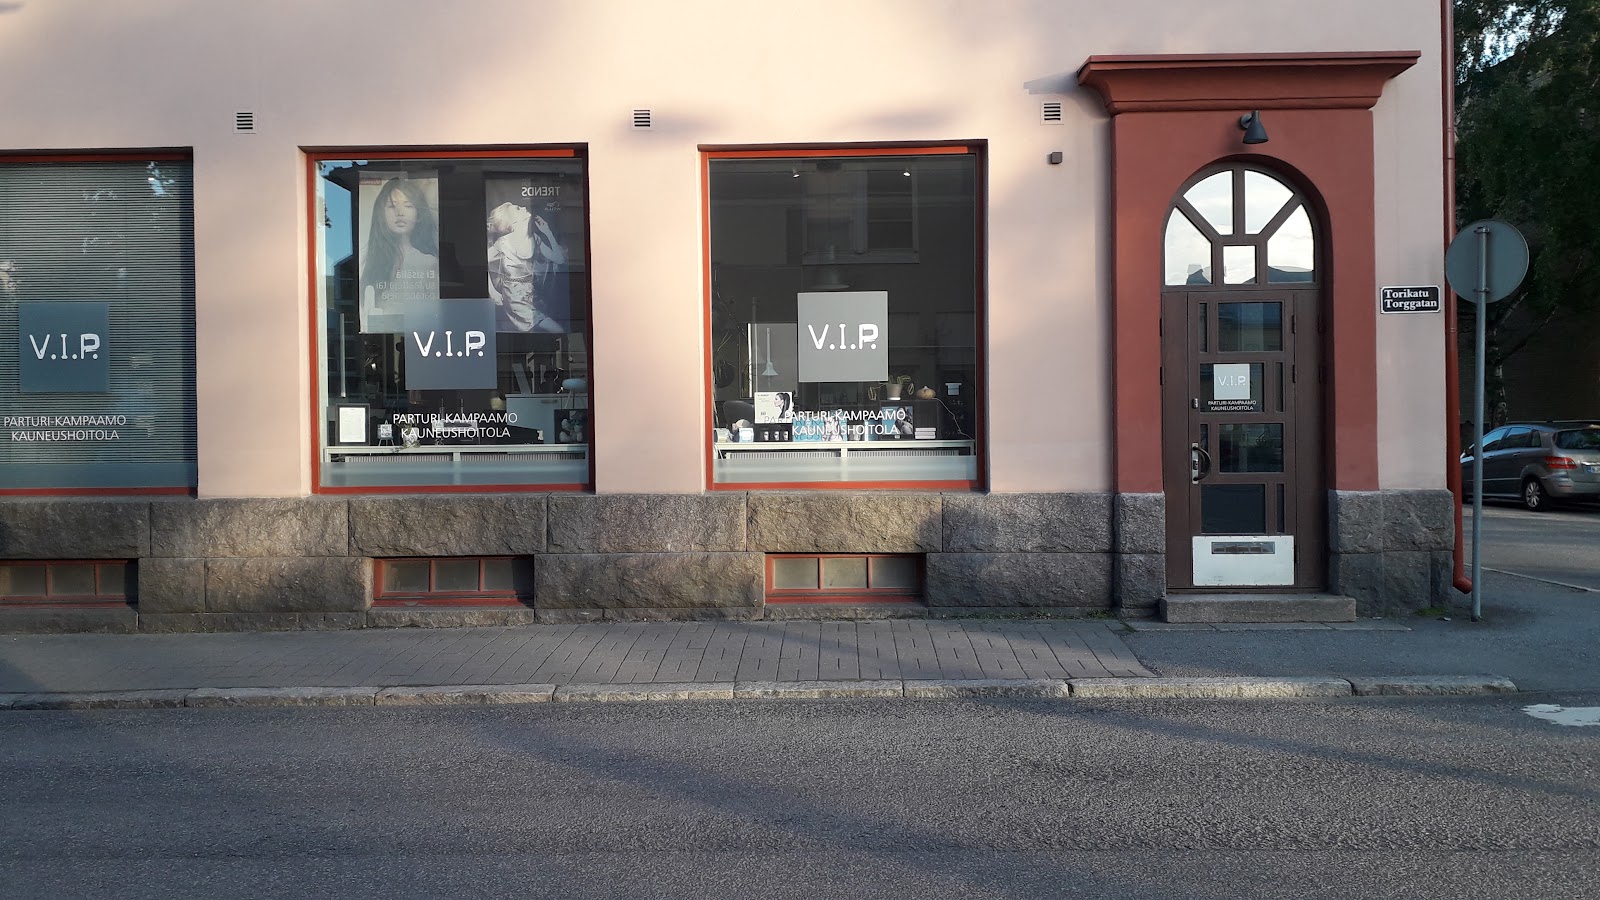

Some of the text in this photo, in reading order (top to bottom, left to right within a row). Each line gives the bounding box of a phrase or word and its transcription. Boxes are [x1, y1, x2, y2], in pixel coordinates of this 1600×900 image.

[1384, 289, 1429, 298] Torikatu
[1384, 299, 1437, 310] Torggatan
[808, 323, 879, 350] V.I.P.
[29, 333, 101, 360] V.I.P.
[413, 330, 486, 358] V.I.P.
[1218, 375, 1246, 386] V.I.P.
[4, 414, 127, 427] PARTURI-KAMPAAMO
[392, 412, 518, 424] PARTURI-KAMPAAMO
[784, 409, 906, 421] PARTURI-KAMPAAMO
[11, 429, 120, 441] KAUNEUSHOITOLA
[401, 427, 511, 439] KAUNEUSHOITOLA
[792, 424, 900, 436] KAUNEUSHOITOLA
